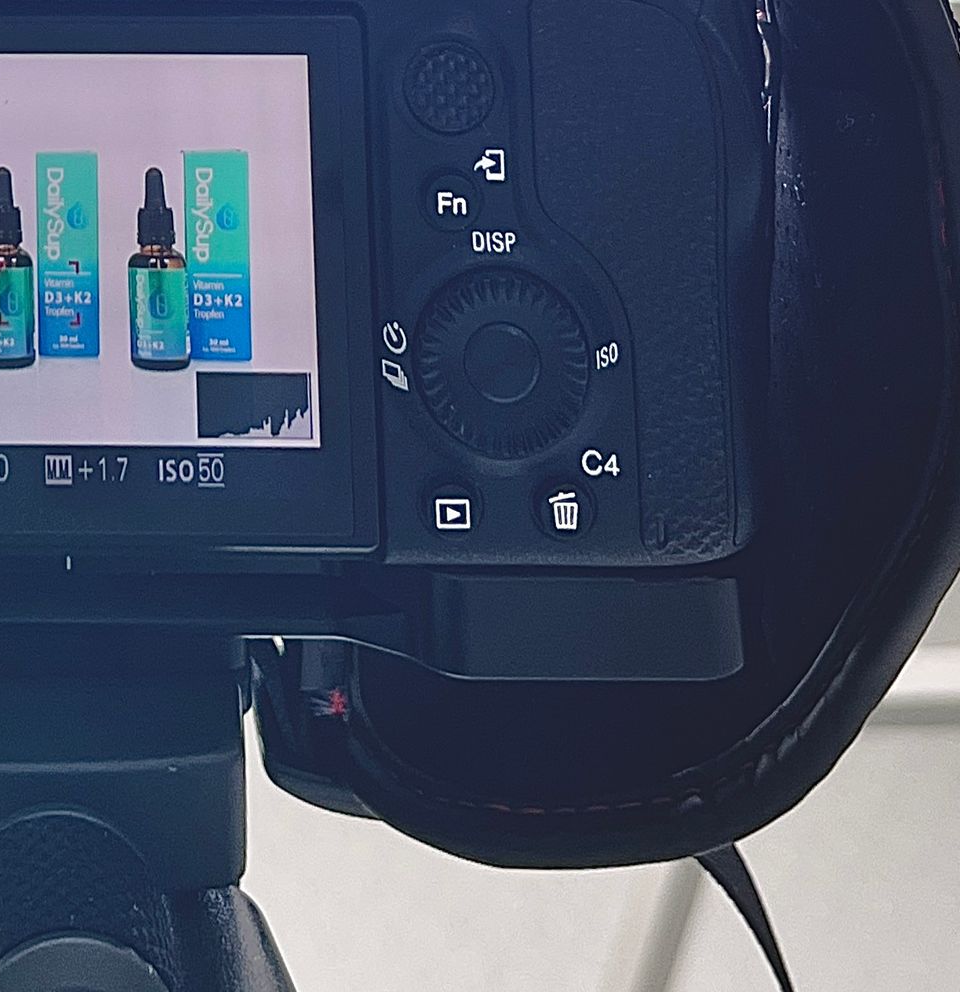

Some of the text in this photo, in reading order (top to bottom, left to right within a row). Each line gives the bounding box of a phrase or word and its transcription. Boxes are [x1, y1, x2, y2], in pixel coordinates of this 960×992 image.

[44, 167, 64, 260] DailySup
[192, 167, 214, 263] DailySup
[437, 191, 468, 216] Fn
[472, 231, 516, 254] DISP
[44, 278, 74, 288] Vitamin
[193, 280, 224, 291] Vitamin
[44, 291, 92, 304] D3+K2
[193, 293, 243, 307] D3+K2
[44, 305, 75, 318] Tropfen
[194, 308, 225, 321] Tropfen
[596, 342, 619, 370] ISO
[78, 457, 128, 482] +1.7
[581, 449, 620, 477] C4
